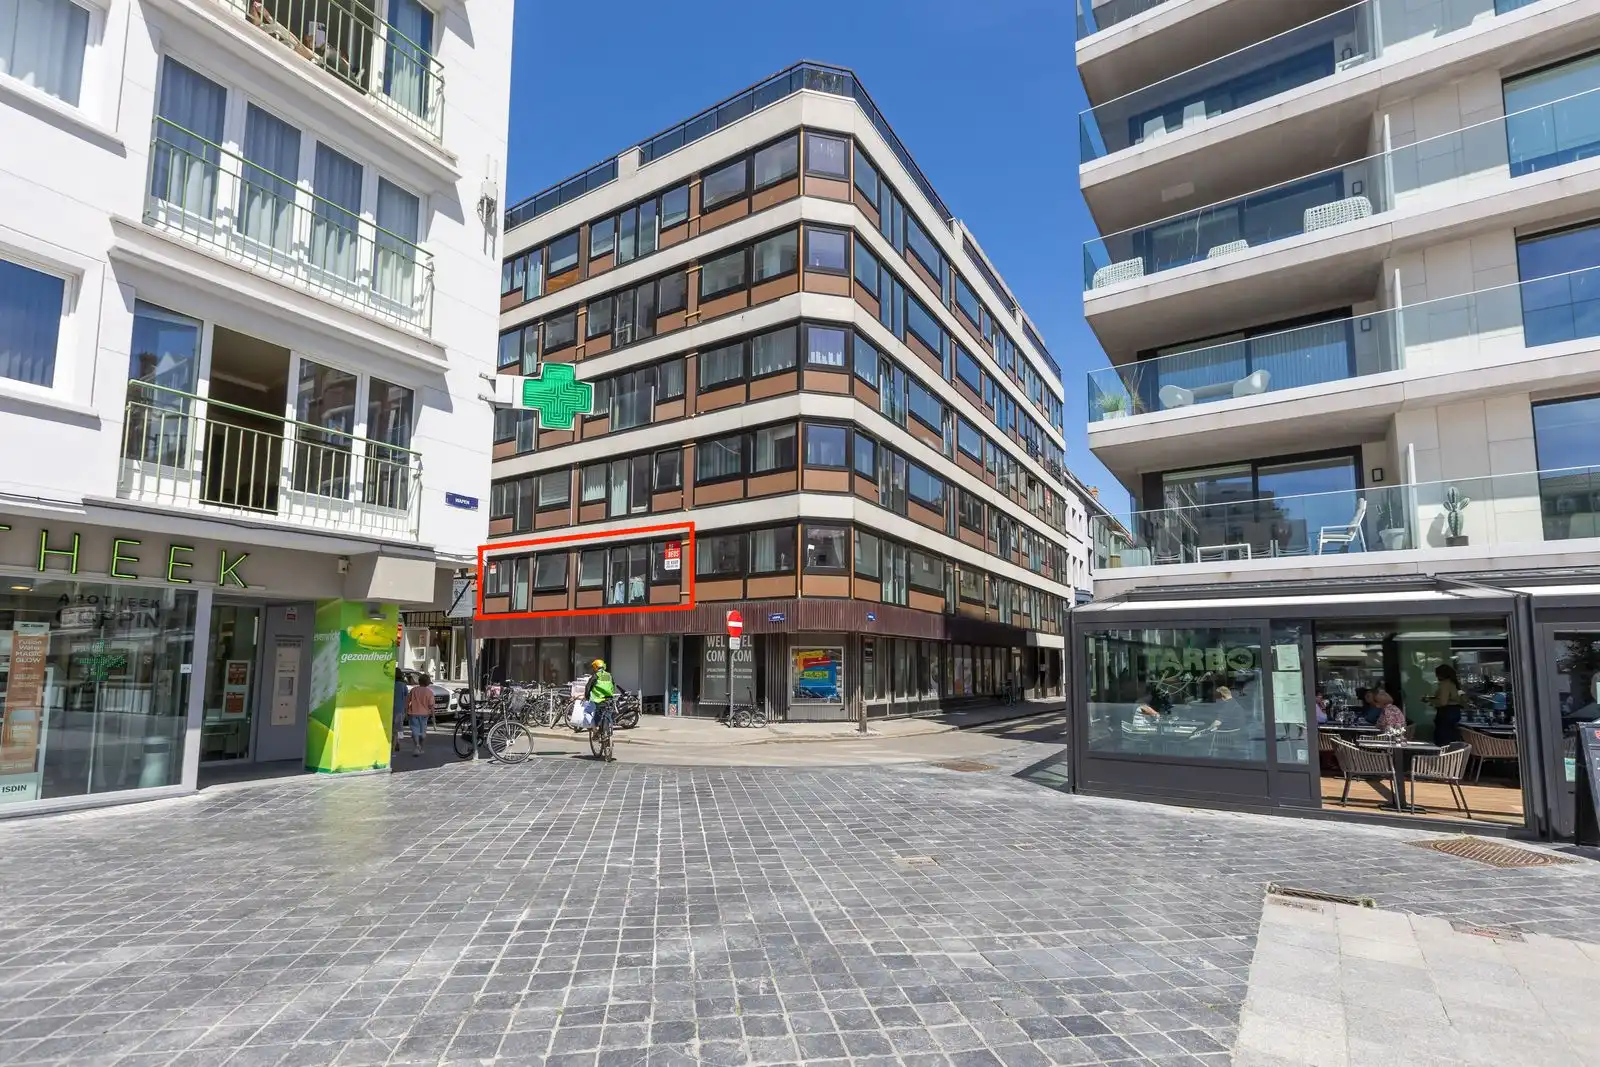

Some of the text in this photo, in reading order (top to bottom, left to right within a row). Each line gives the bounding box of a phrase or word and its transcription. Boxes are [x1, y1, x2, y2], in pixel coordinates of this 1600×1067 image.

[57, 593, 160, 609] APOTHEEK
[706, 635, 726, 648] WEL
[341, 652, 393, 663] gezondheid
[706, 650, 725, 662] COM
[2, 784, 27, 793] ISDIN
